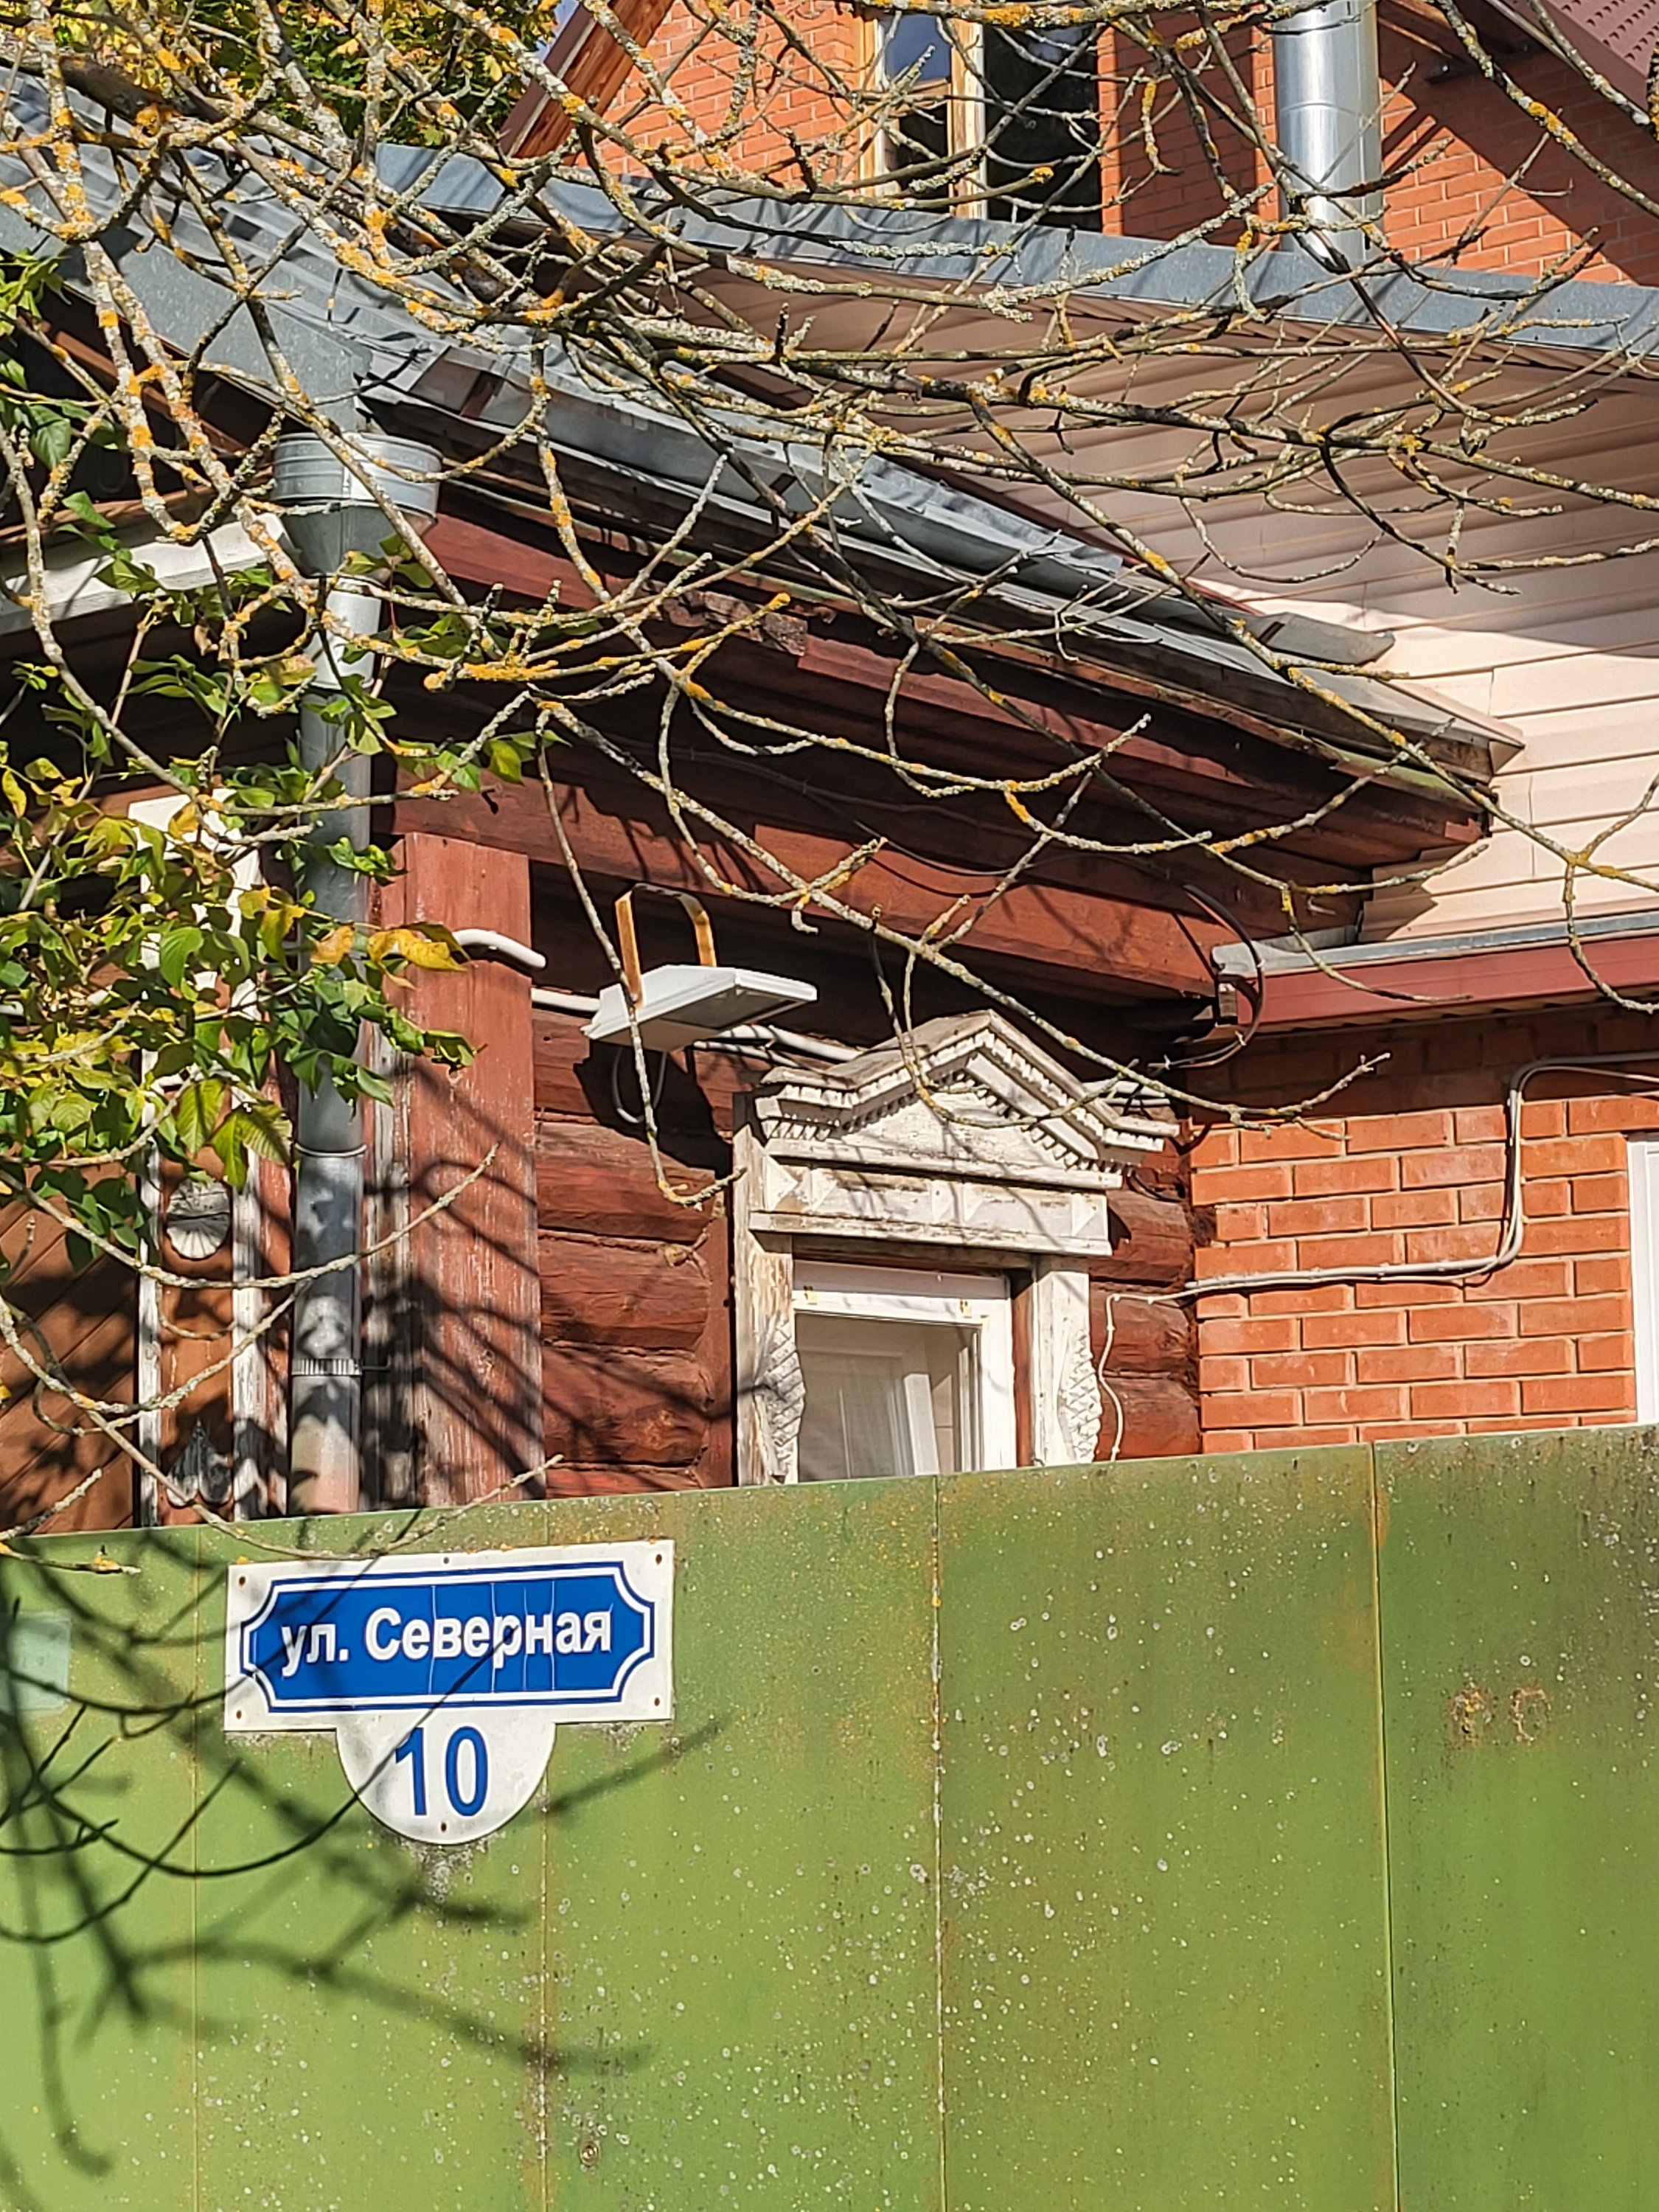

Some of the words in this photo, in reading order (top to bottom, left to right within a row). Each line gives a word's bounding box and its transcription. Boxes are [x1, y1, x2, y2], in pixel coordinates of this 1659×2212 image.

[281, 1622, 349, 1677] ул.
[364, 1607, 611, 1669] Северная
[395, 1726, 489, 1817] 10
